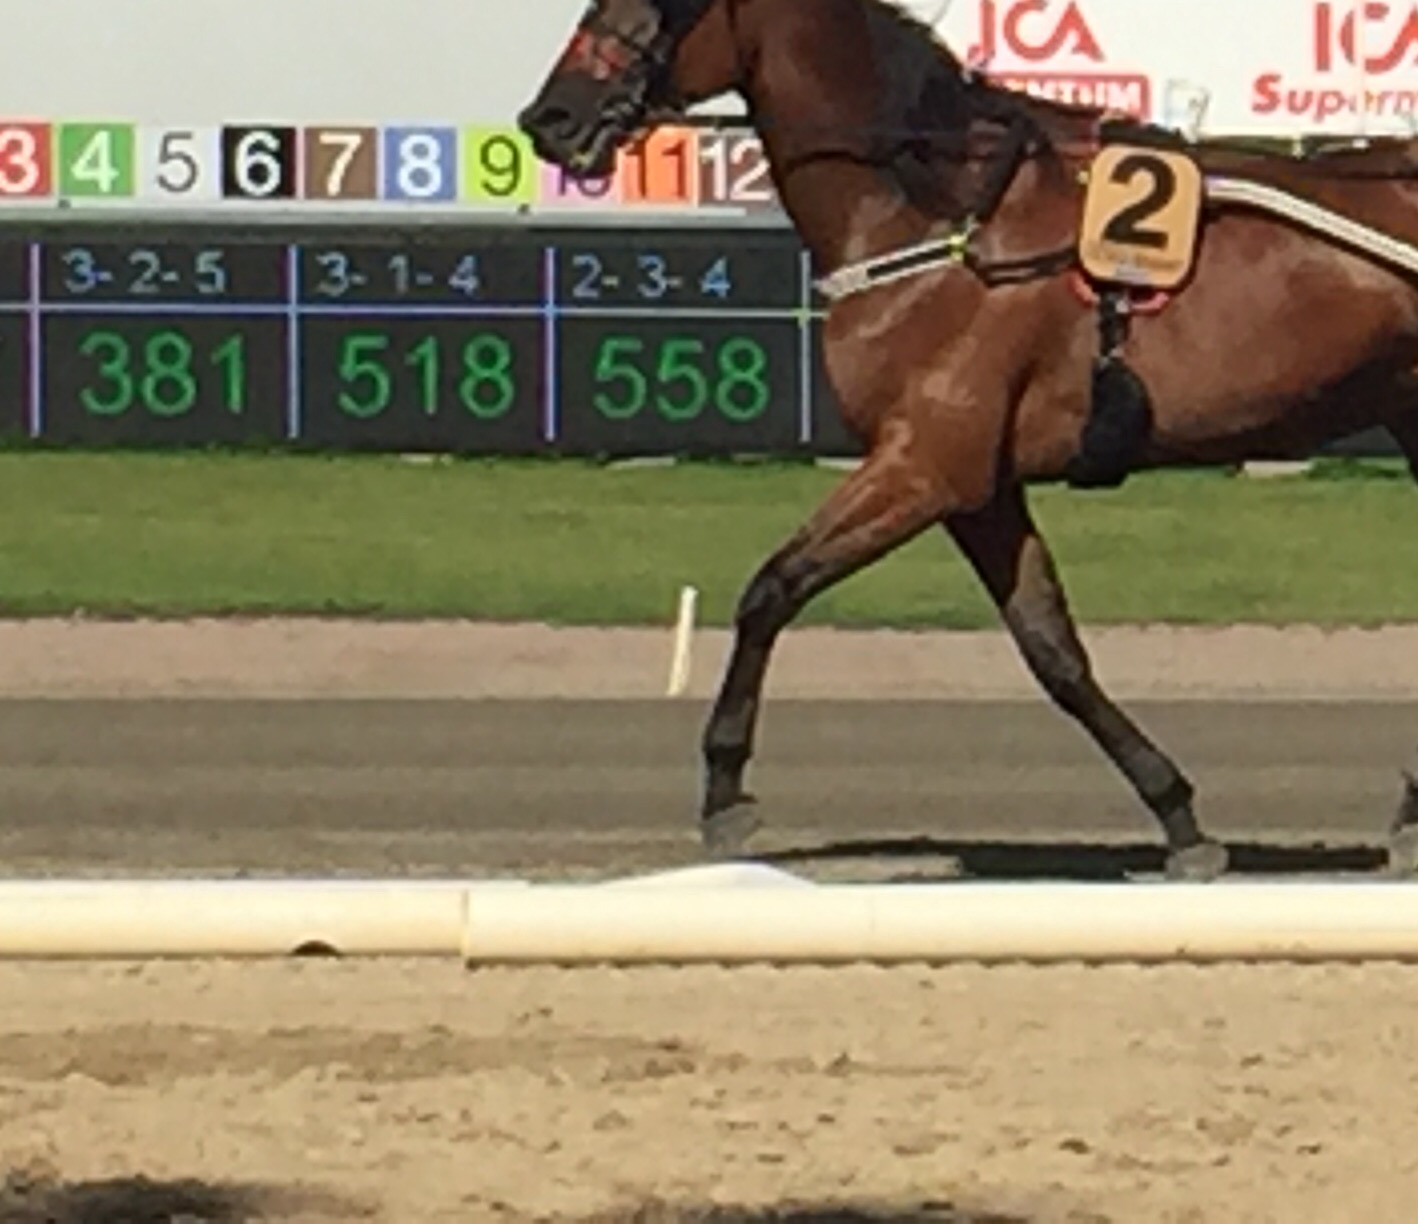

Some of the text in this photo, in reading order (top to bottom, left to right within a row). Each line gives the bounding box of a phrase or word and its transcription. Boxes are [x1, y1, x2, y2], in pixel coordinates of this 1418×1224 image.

[0, 129, 39, 195] 3
[70, 129, 119, 194] 4
[156, 131, 199, 193] 5
[234, 130, 282, 197] 6
[318, 133, 363, 197] 7
[398, 133, 442, 198] 8
[479, 135, 522, 197] 9
[624, 138, 688, 199] 11
[701, 137, 772, 201] 12
[1102, 153, 1177, 250] 2
[78, 331, 247, 417] 381
[337, 333, 516, 419] 518
[592, 337, 771, 423] 558
